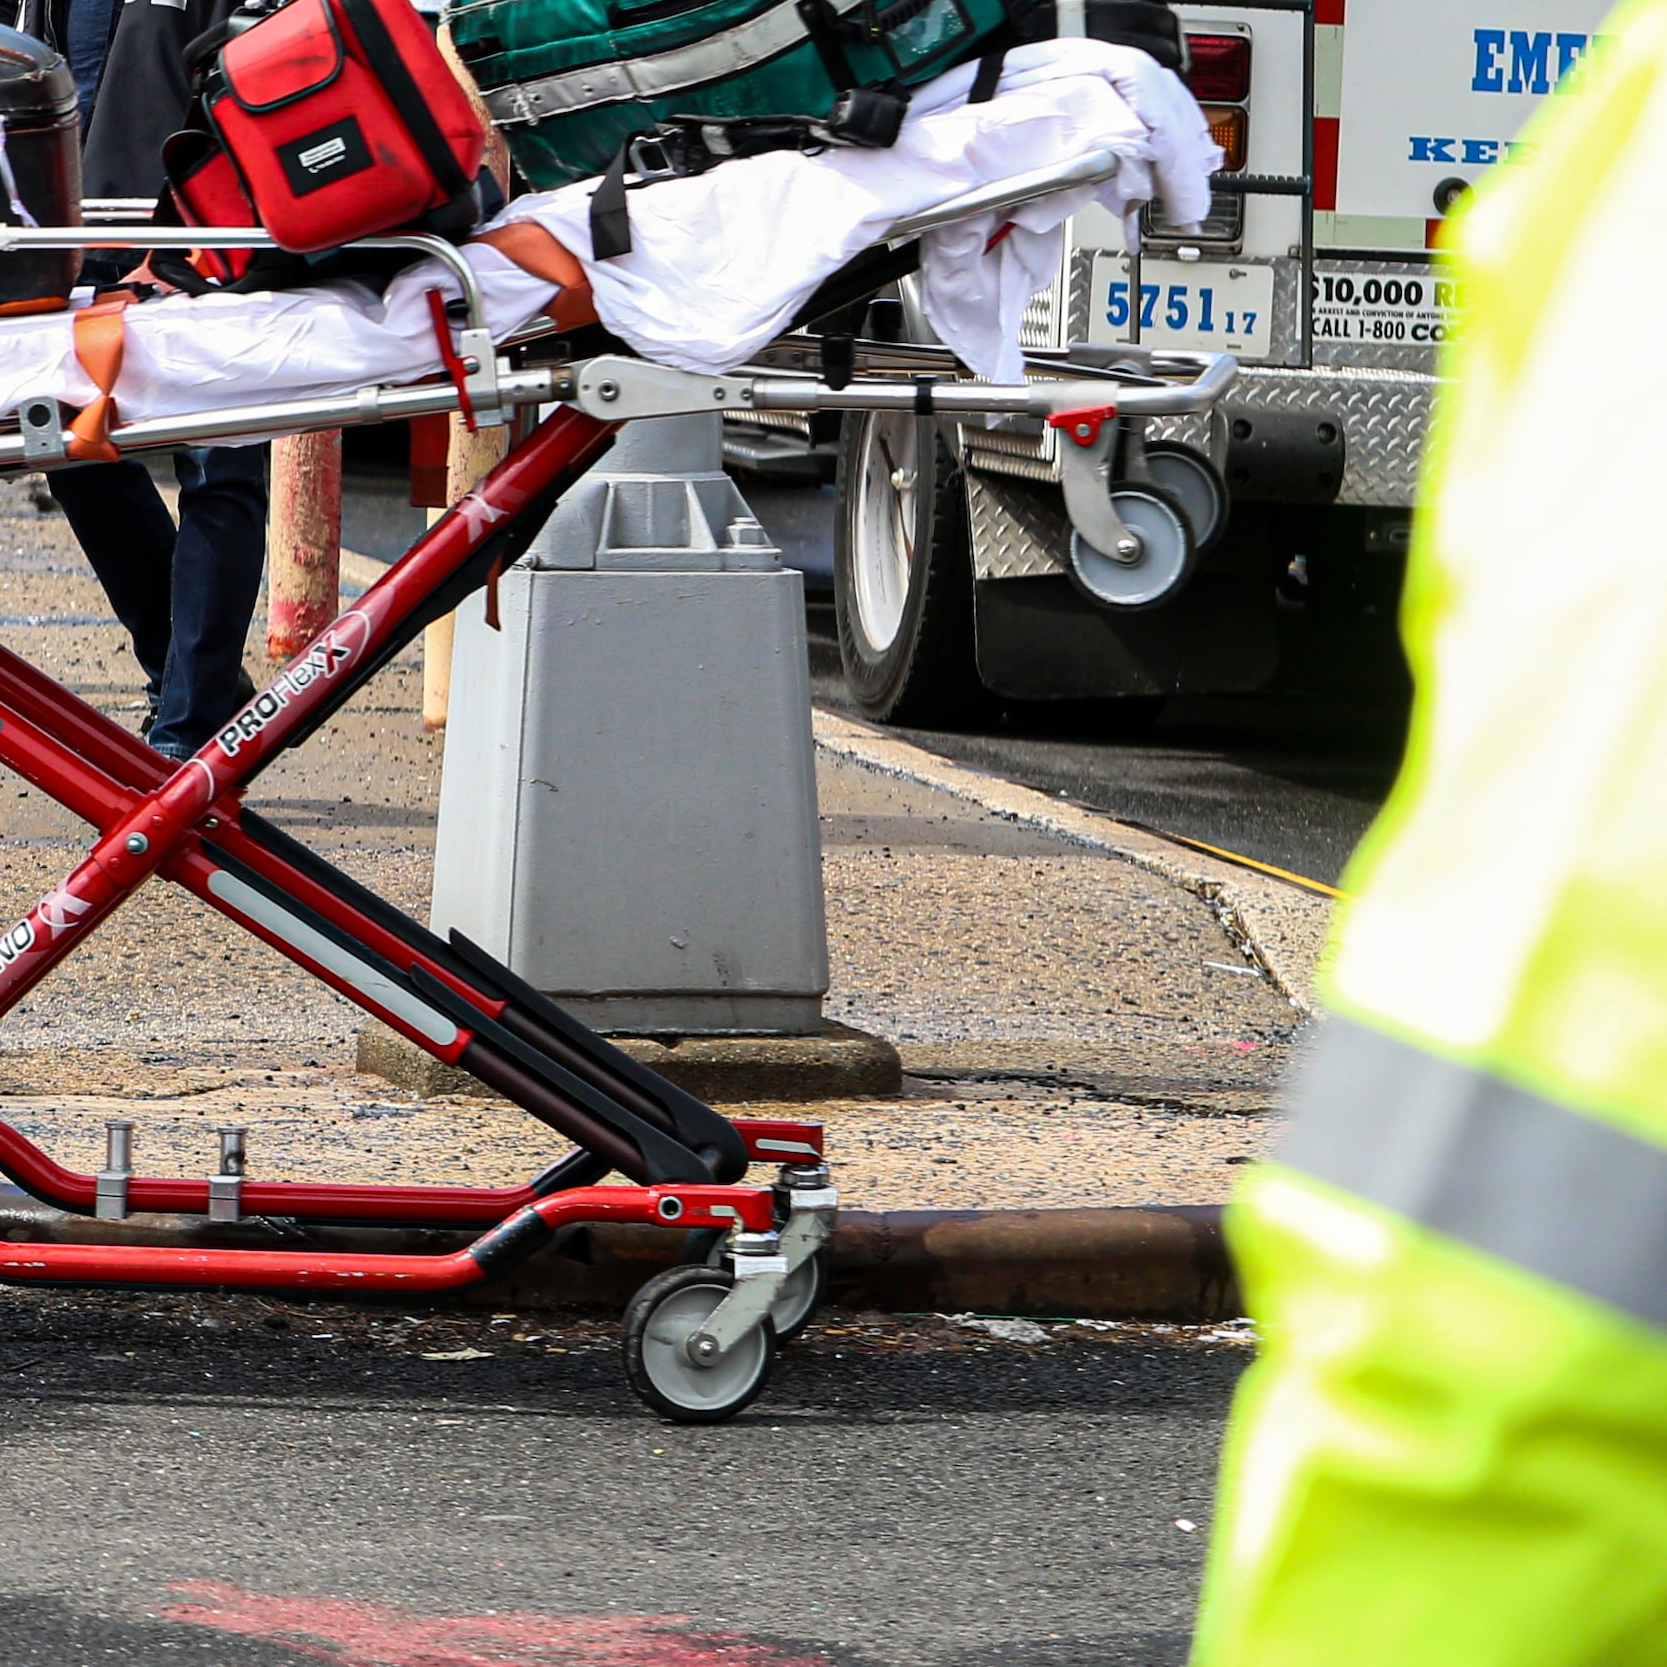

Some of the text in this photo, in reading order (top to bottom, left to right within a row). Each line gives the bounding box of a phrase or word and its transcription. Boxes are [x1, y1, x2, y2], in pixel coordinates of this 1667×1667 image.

[1105, 281, 1258, 335] 5751 17
[1312, 317, 1352, 338] CALL
[1358, 319, 1406, 340] 1-800
